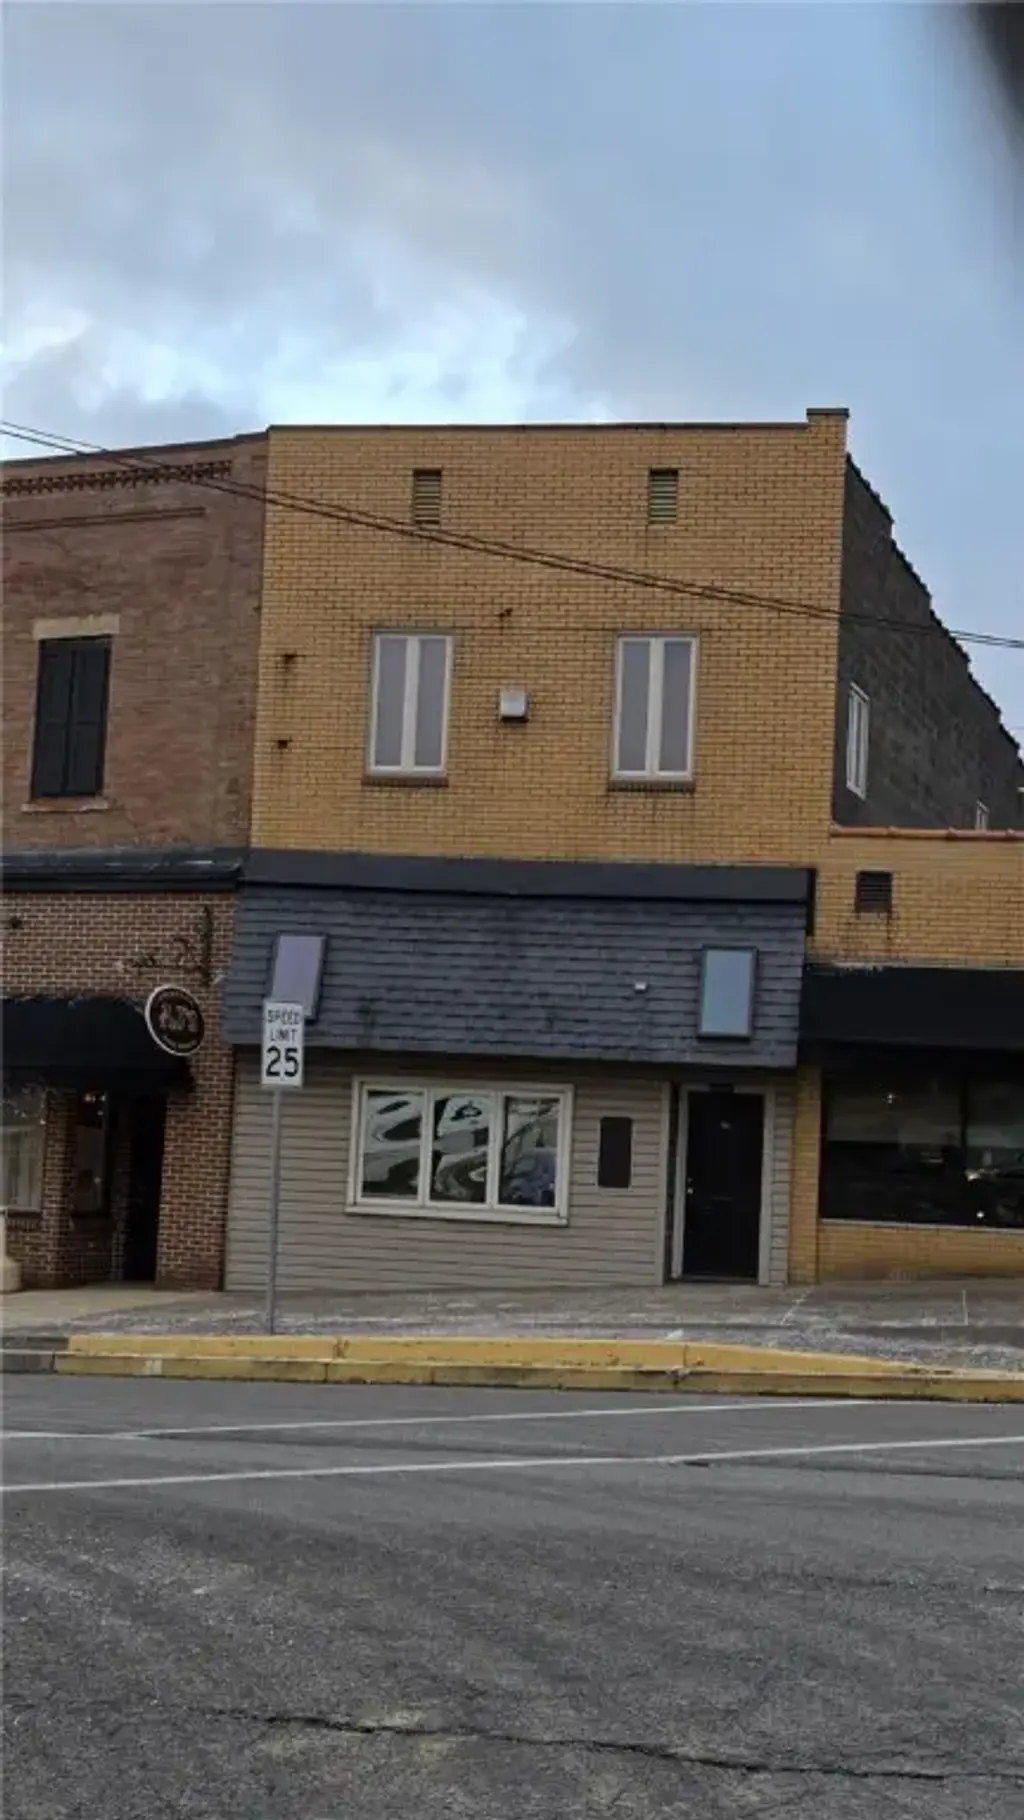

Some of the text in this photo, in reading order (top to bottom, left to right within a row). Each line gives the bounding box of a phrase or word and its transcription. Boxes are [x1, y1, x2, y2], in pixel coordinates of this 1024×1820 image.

[267, 1009, 300, 1025] SPEED
[270, 1028, 297, 1043] LIMIT
[266, 1046, 299, 1077] 25
